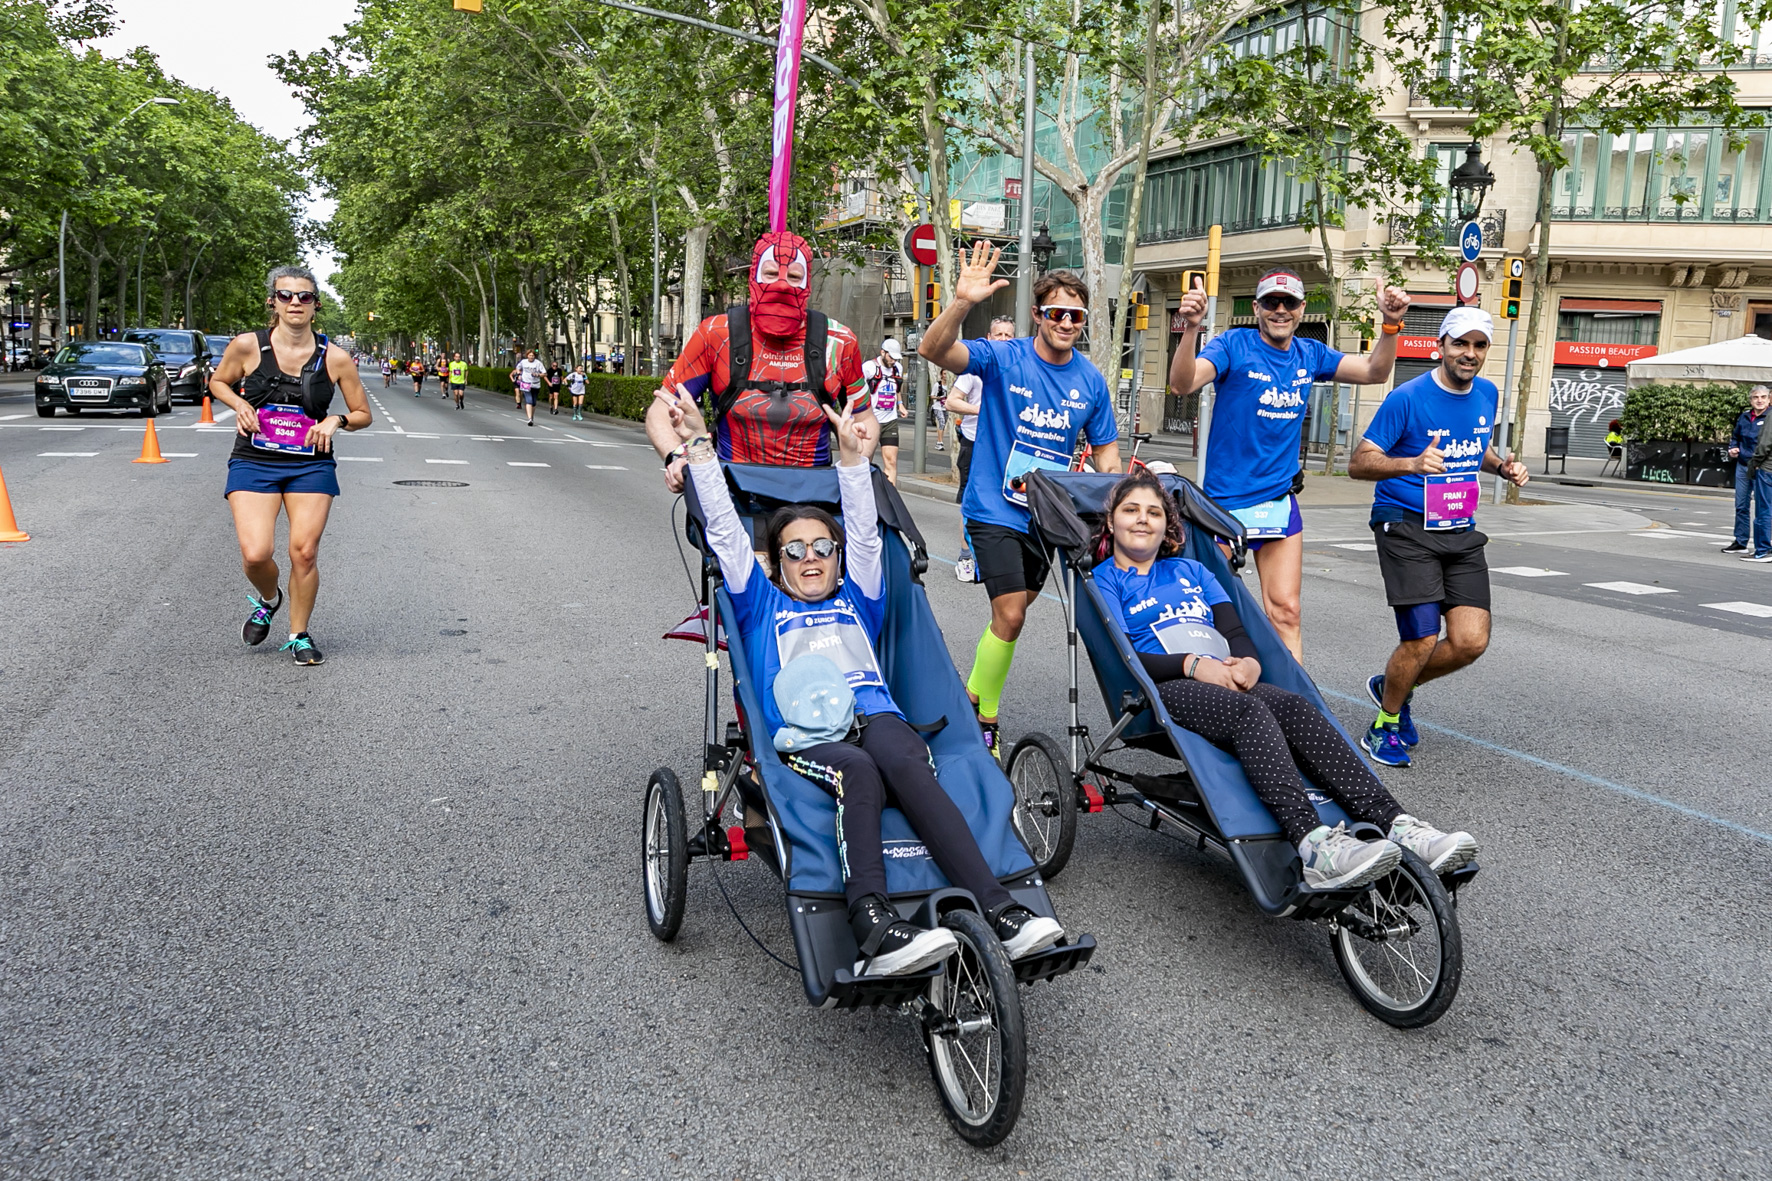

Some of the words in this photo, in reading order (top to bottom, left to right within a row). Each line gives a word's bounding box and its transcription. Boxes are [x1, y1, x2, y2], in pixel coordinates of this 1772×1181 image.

[1403, 340, 1437, 348] PASSION
[1569, 346, 1606, 355] PASSION
[1248, 370, 1272, 382] aefat
[1009, 384, 1033, 399] aefat
[1061, 399, 1088, 410] ZURICH
[269, 418, 302, 428] MONICA
[274, 428, 296, 437] 5348
[1443, 492, 1462, 500] FRAN
[1462, 491, 1467, 499] J
[1447, 502, 1464, 510] 1015
[1254, 511, 1269, 519] 337
[813, 616, 836, 624] ZURICH
[809, 635, 842, 652] PATRI
